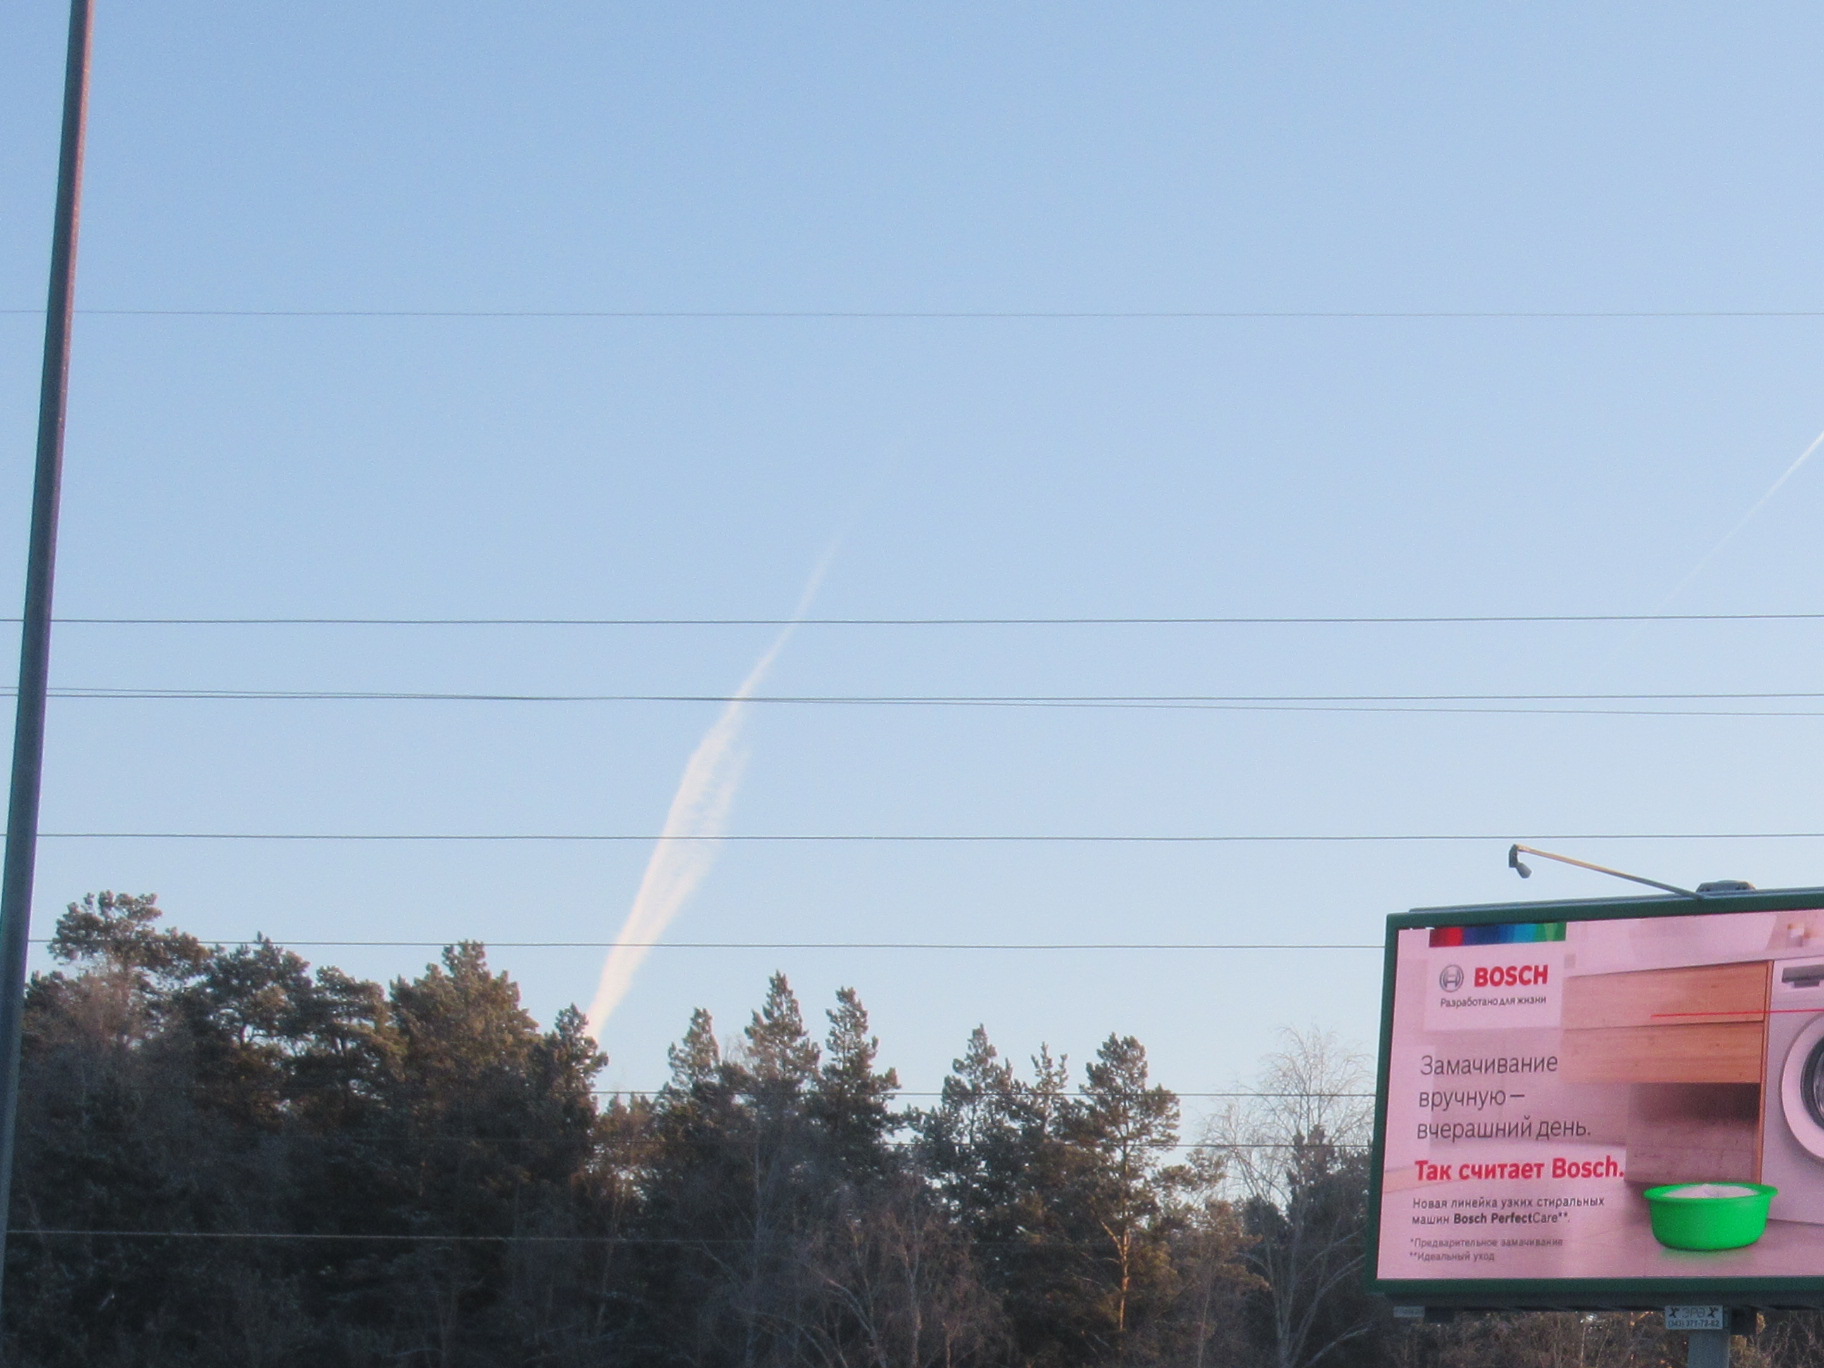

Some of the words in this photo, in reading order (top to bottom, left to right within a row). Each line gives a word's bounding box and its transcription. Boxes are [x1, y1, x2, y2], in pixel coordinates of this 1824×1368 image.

[1474, 964, 1549, 988] BOSCH
[1440, 997, 1499, 1009] Разработано
[1499, 998, 1516, 1006] для
[1517, 996, 1547, 1005] жизни
[1420, 1054, 1558, 1076] Замачивание
[1418, 1089, 1506, 1112] вручную
[1416, 1115, 1532, 1143] вчерашний
[1536, 1119, 1592, 1141] день.
[1414, 1159, 1452, 1181] Так
[1458, 1161, 1545, 1181] считает
[1551, 1155, 1625, 1179] Bosch.
[1412, 1198, 1448, 1210] Новая
[1450, 1196, 1498, 1209] линейка
[1500, 1198, 1533, 1210] узких
[1536, 1197, 1605, 1211] стиральных
[1411, 1214, 1450, 1225] машин
[1453, 1212, 1487, 1225] Bosch
[1501, 1238, 1564, 1248] замачивание
[1473, 1252, 1496, 1263] уход
